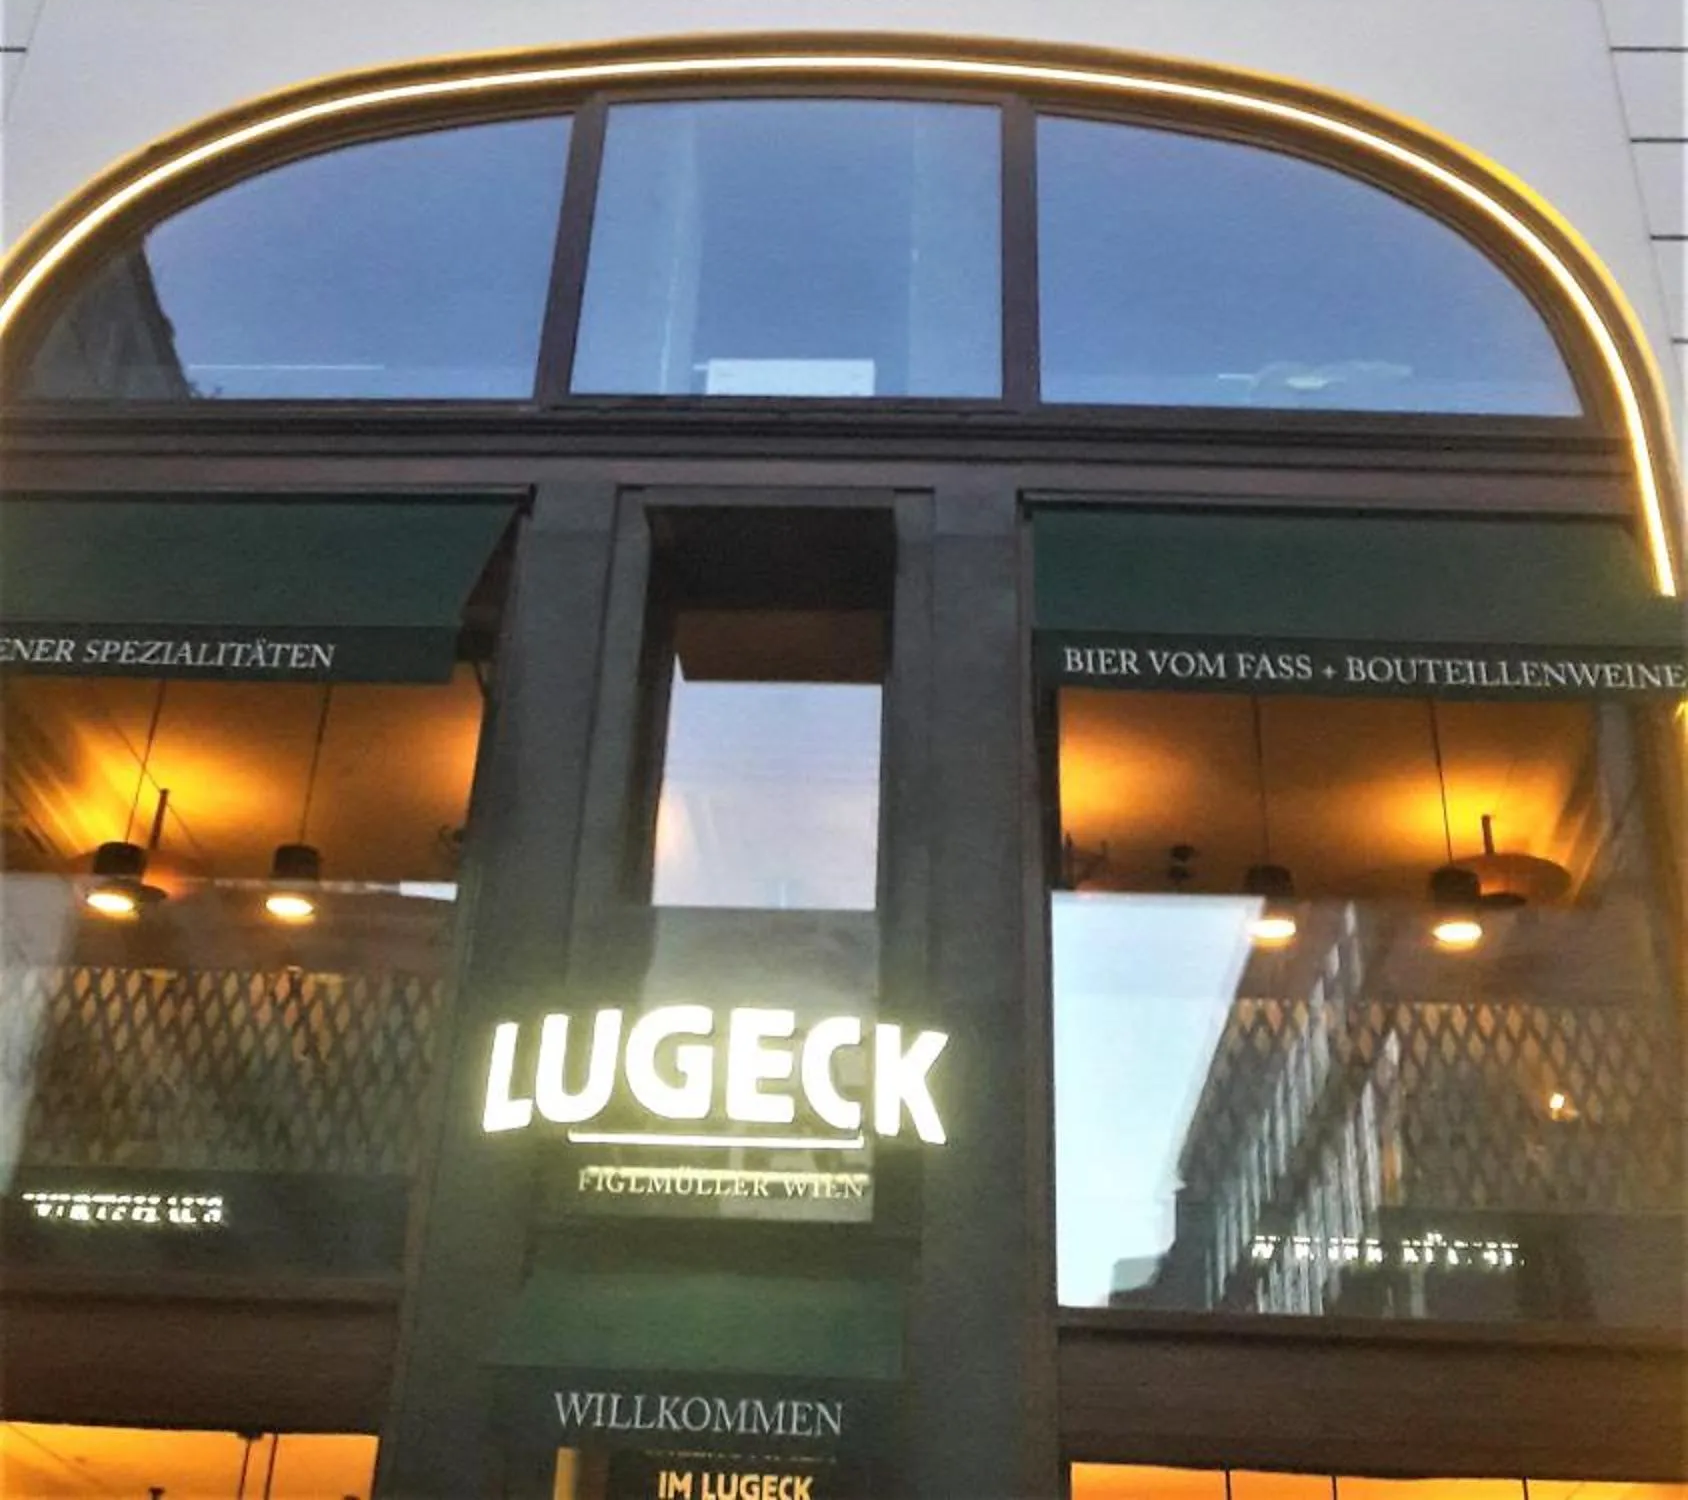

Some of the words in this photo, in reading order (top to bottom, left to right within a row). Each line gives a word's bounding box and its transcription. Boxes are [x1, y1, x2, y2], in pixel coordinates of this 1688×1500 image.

[82, 638, 336, 669] SPEZIALITÄTEN
[1064, 647, 1137, 673] BIER
[1147, 650, 1226, 678] VOM
[1237, 653, 1312, 680] FASS
[1344, 655, 1687, 689] BOUTEILLENWEINE
[482, 1004, 949, 1145] LUGECK
[578, 1166, 769, 1198] FIGLMÜLLER
[784, 1171, 868, 1199] WIEN
[554, 1392, 843, 1436] WILLKOMMEN
[658, 1470, 693, 1499] IM
[701, 1472, 814, 1500] LUGECK
